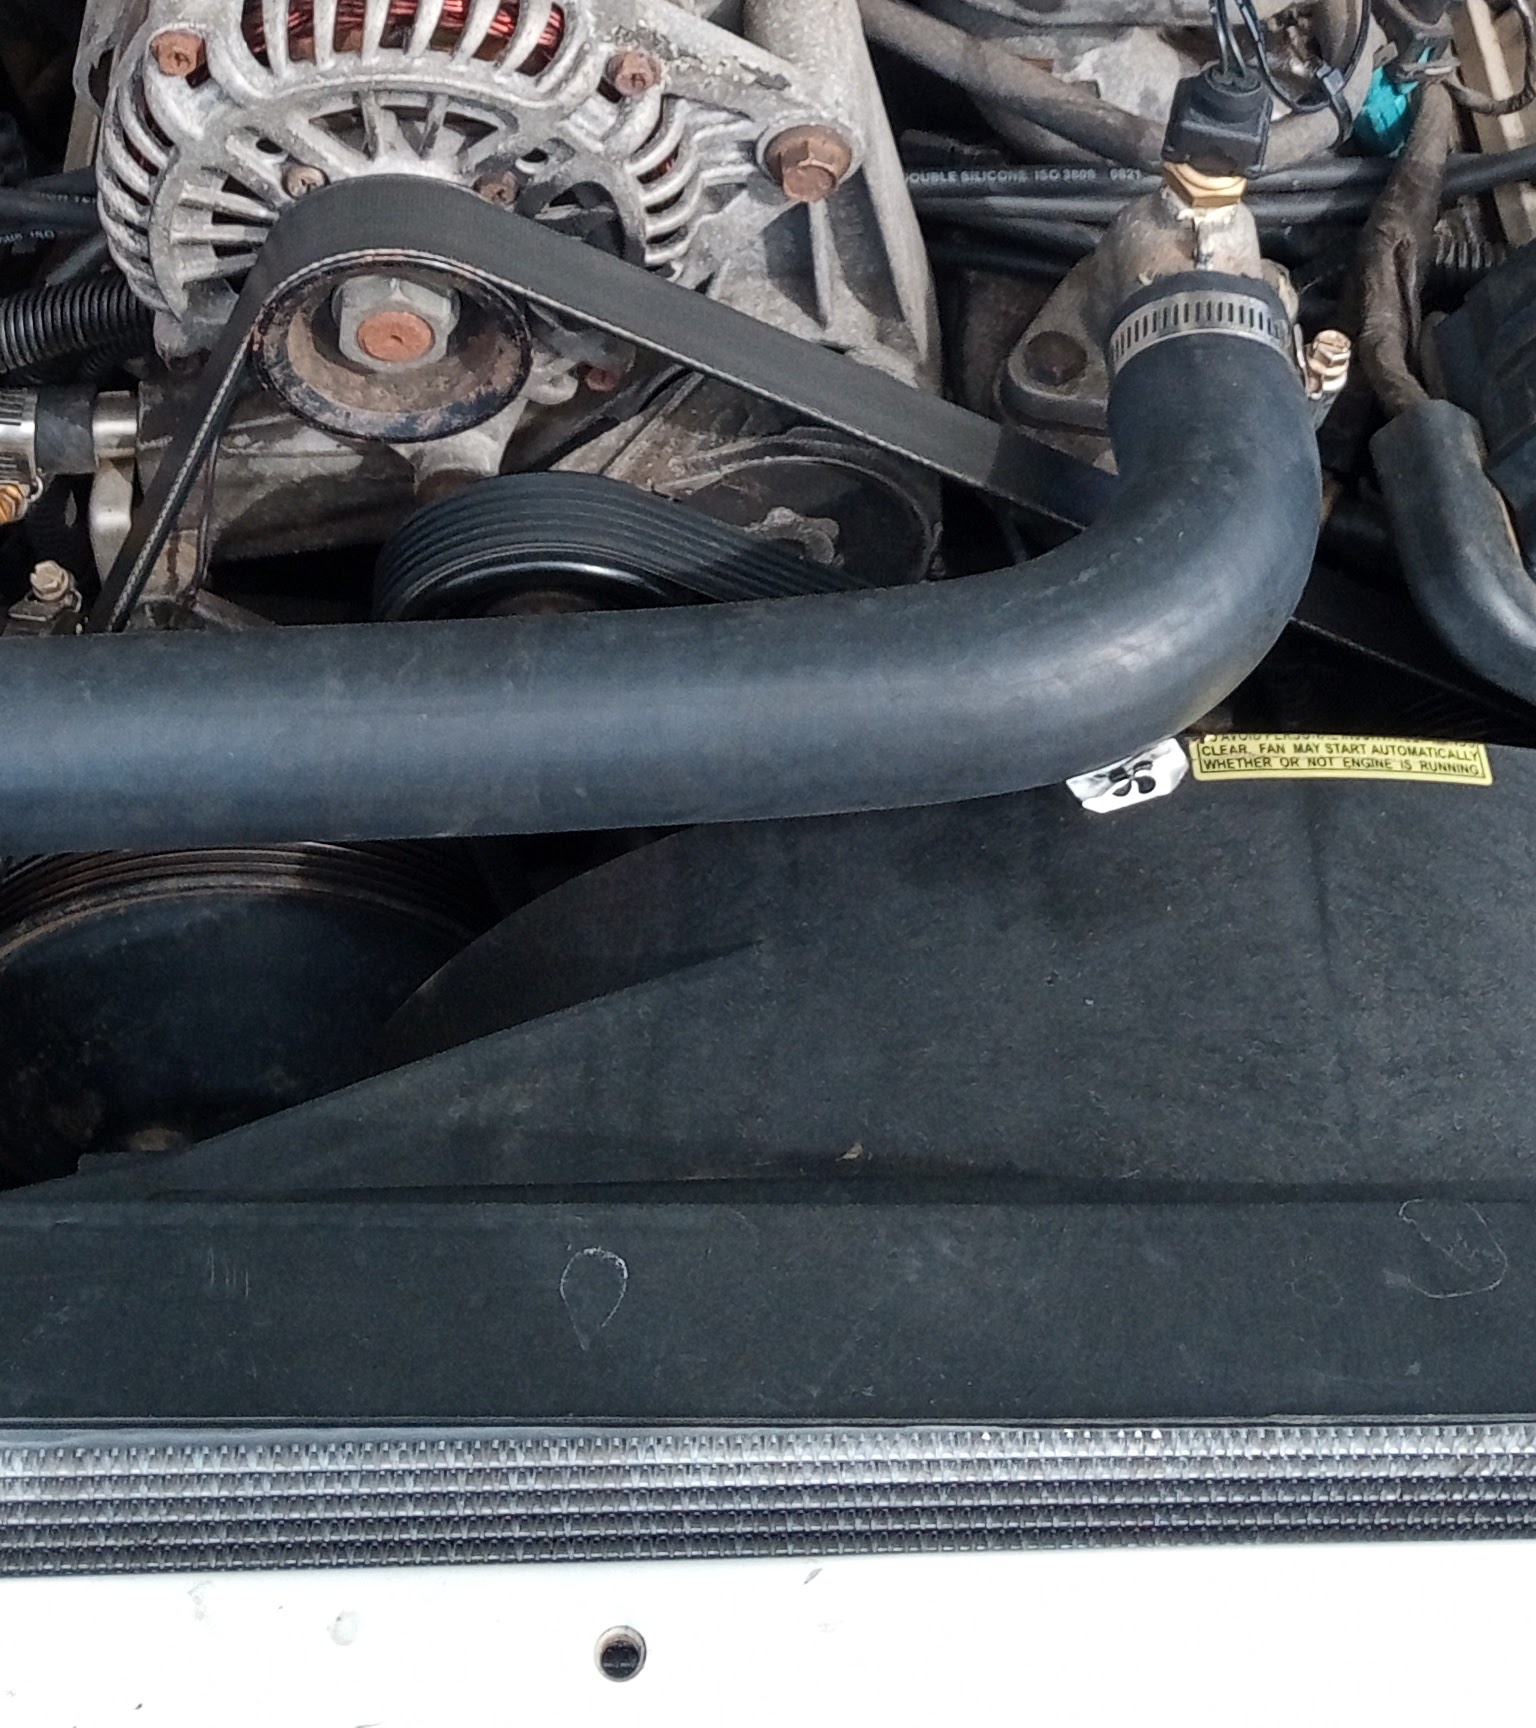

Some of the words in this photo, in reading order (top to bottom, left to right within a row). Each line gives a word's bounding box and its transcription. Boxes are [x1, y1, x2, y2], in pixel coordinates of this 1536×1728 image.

[960, 171, 1028, 184] SILICONE
[1034, 170, 1060, 181] ISO
[1260, 744, 1284, 754] FAN
[1294, 743, 1320, 754] MAY
[1325, 744, 1366, 755] START
[1372, 745, 1479, 761] AUTOMATICALLY
[1203, 758, 1272, 770] WHETHER
[1280, 758, 1300, 768] OR
[1307, 757, 1336, 767] NOT
[1343, 758, 1392, 769] ENGINE
[1400, 759, 1412, 769] IS
[1419, 760, 1479, 775] RUNNING
